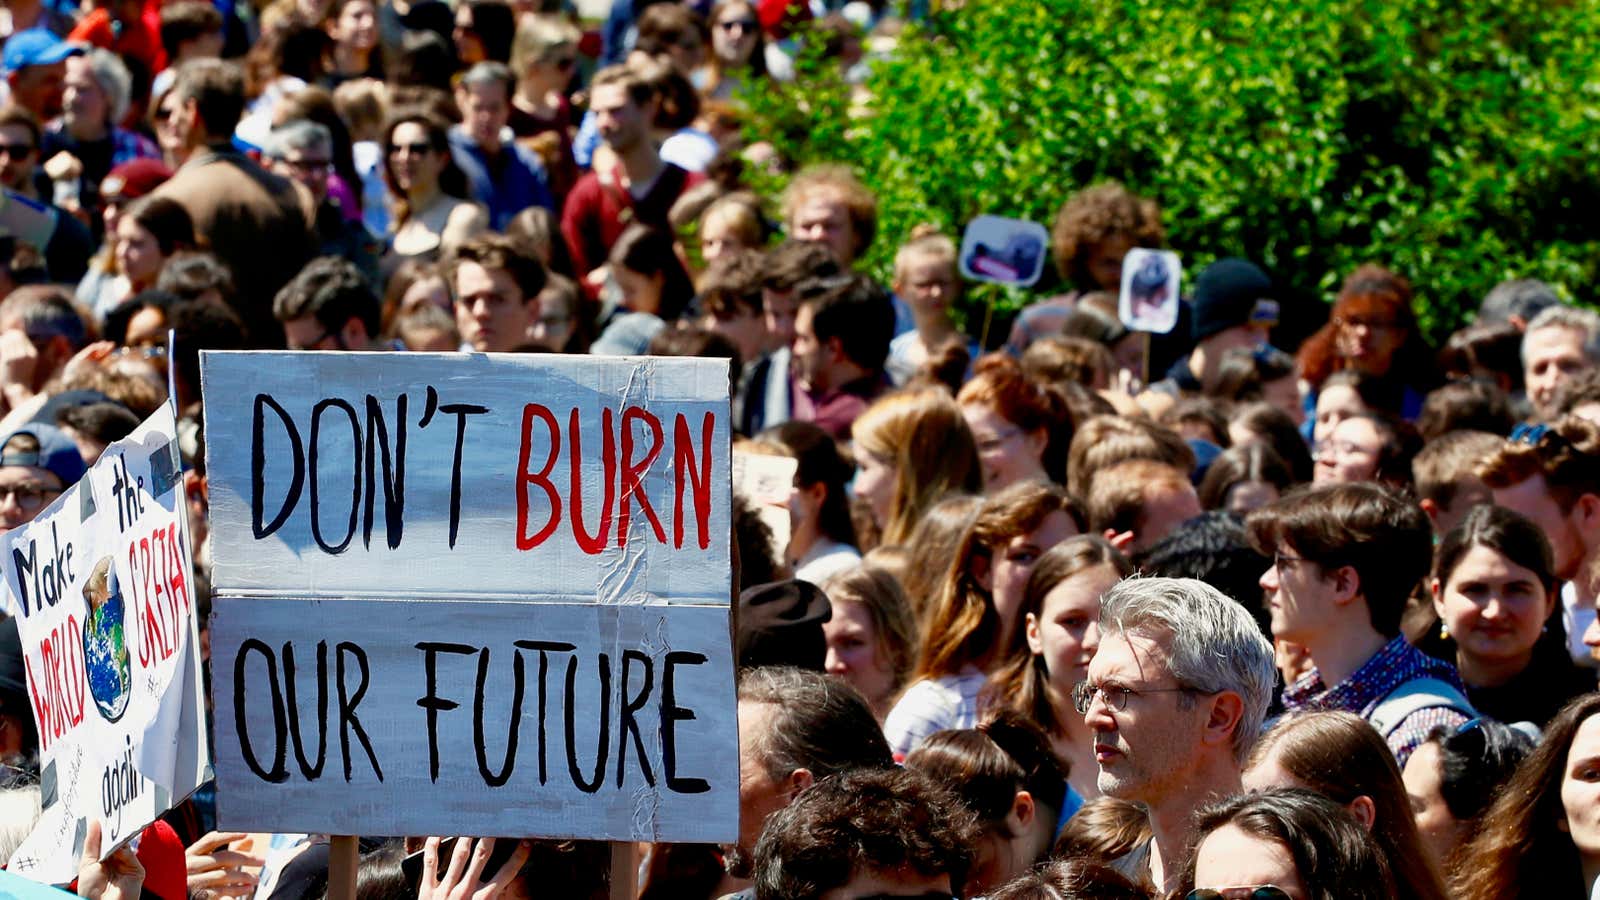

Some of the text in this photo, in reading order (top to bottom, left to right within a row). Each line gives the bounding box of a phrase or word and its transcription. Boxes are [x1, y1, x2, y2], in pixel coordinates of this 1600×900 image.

[13, 453, 144, 618] Make the
[252, 386, 714, 554] DON'T BURN
[25, 521, 190, 751] WORLD GRETA
[234, 638, 711, 793] OUR FUTURE
